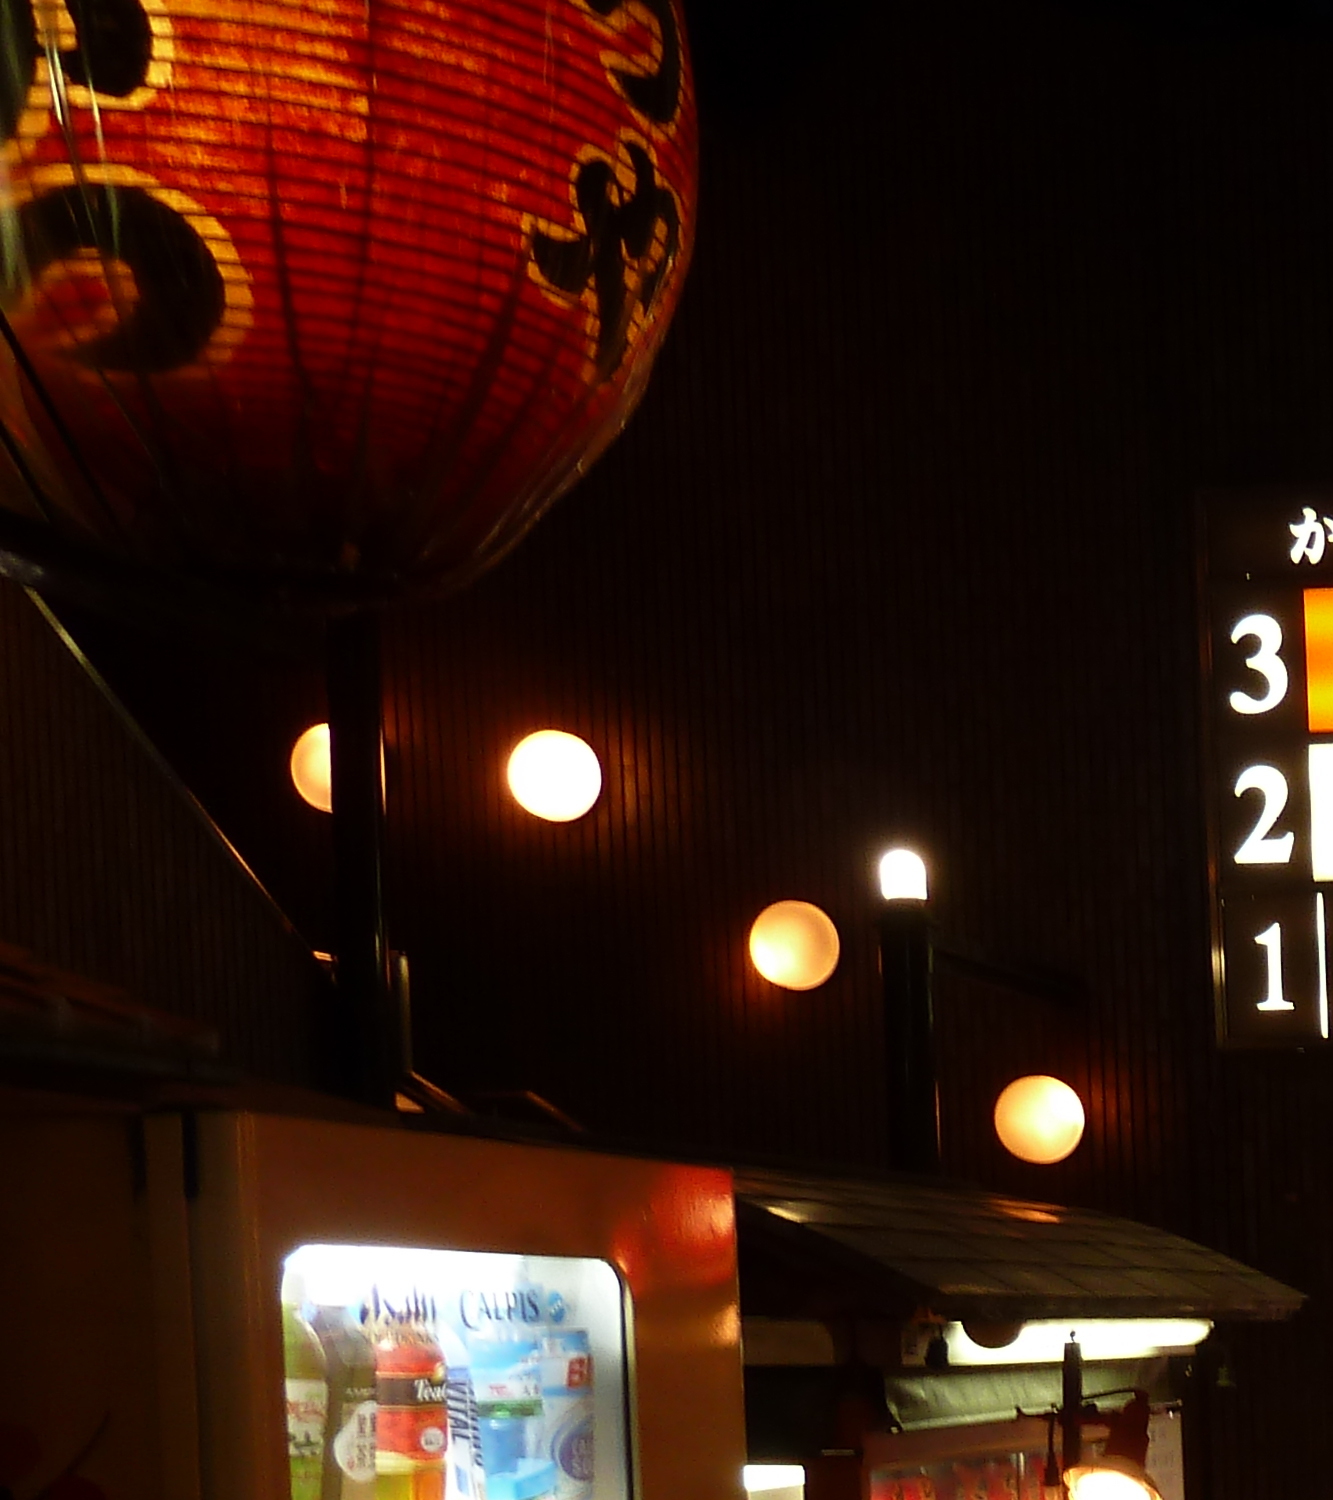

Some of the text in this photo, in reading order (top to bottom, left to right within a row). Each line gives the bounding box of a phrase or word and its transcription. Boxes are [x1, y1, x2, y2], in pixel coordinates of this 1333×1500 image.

[1229, 614, 1288, 714] 3
[1234, 765, 1294, 864] 2
[1254, 922, 1295, 1011] 1
